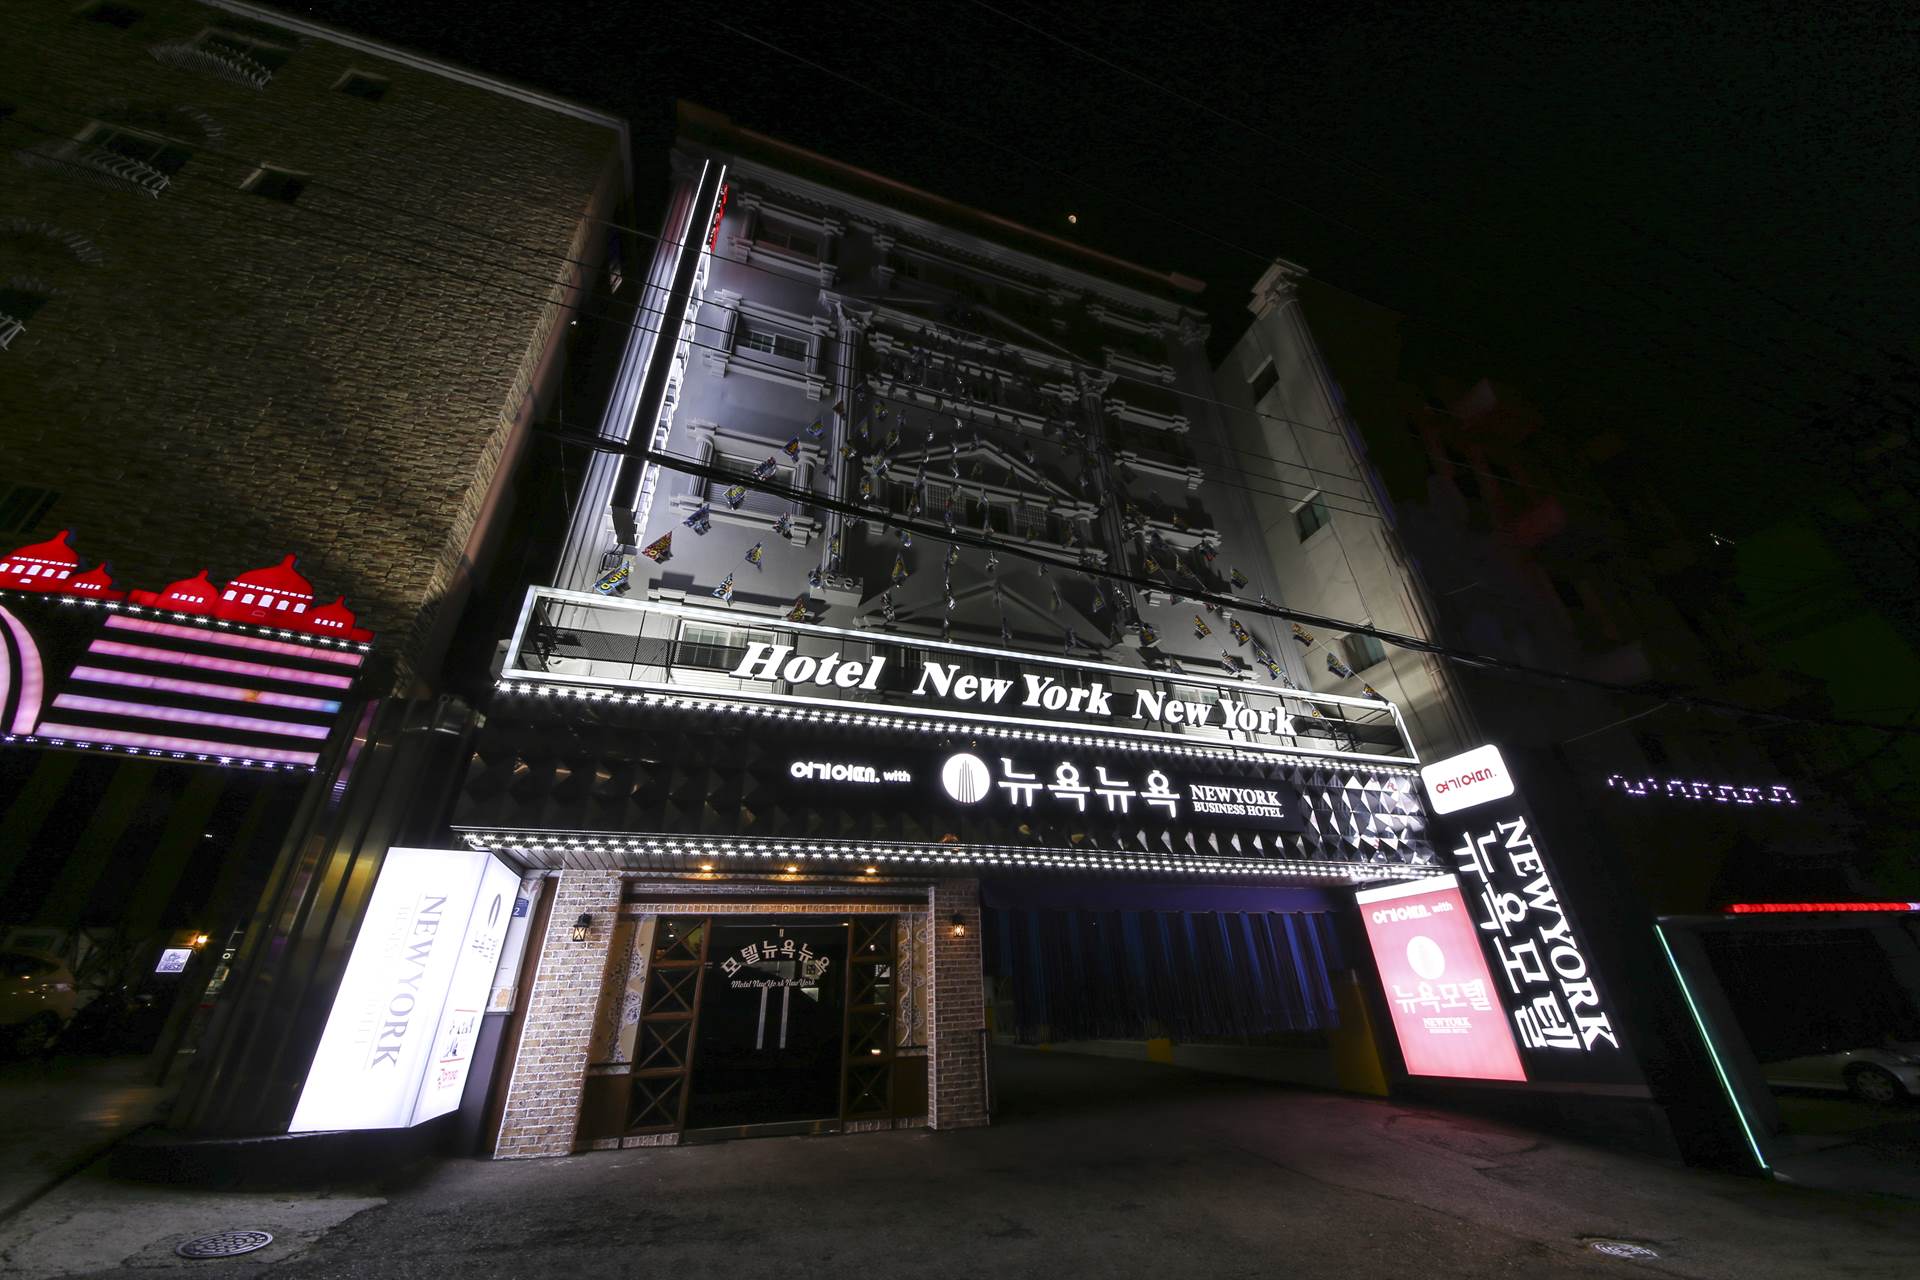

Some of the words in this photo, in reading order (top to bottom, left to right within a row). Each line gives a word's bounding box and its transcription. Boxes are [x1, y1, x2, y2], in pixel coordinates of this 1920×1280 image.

[730, 641, 886, 690] Hotel
[912, 660, 1014, 705] New
[1022, 672, 1113, 716] York
[1131, 688, 1213, 727] New
[1217, 697, 1298, 737] York
[883, 769, 911, 783] with
[999, 756, 1182, 819] 뉴욕뉴욕
[1192, 800, 1246, 816] BUSINESS
[1246, 804, 1285, 818] HOTEL
[1453, 829, 1582, 1050] 뉴욕모텔
[731, 980, 753, 989] Motel
[1392, 978, 1492, 1014] 뉴욕모텔
